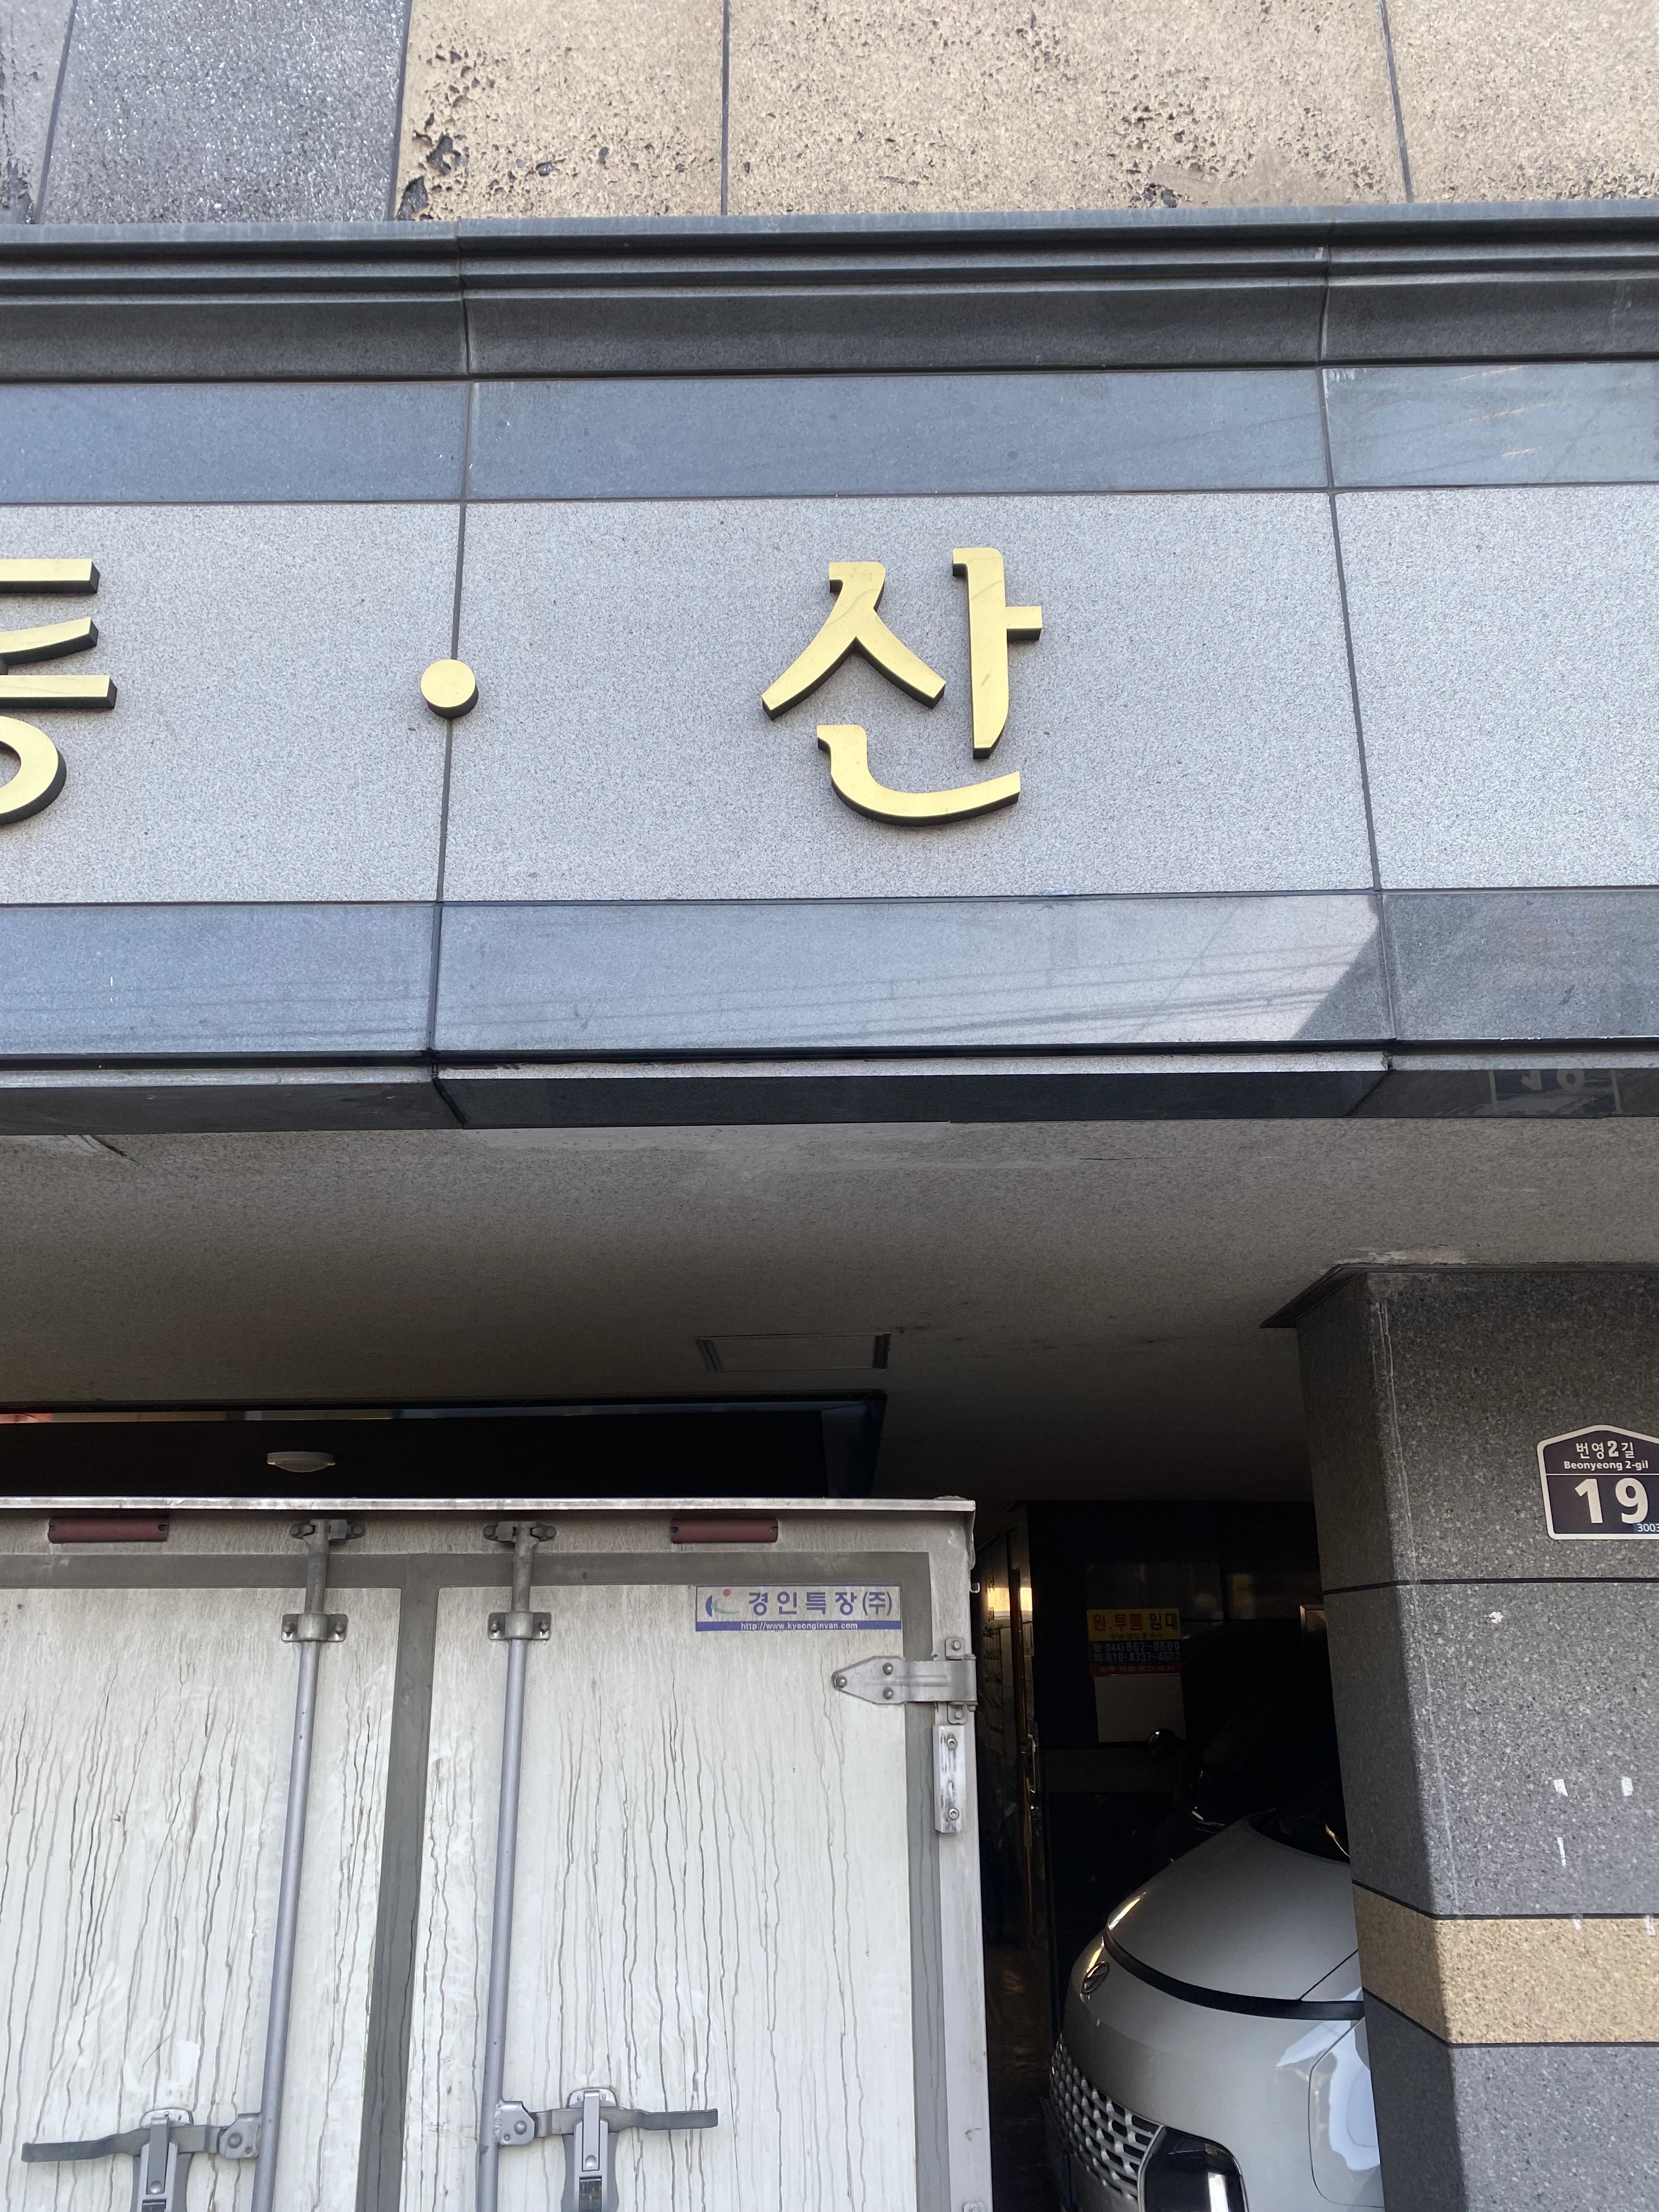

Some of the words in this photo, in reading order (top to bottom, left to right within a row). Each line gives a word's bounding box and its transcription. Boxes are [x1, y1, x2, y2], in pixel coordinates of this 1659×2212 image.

[761, 547, 1043, 826] 산
[1576, 1440, 1635, 1459] 번영2길
[1564, 1460, 1623, 1471] Beonyeong
[1626, 1460, 1649, 1471] 2-gil
[1575, 1477, 1649, 1524] 19
[741, 1622, 858, 1631] http://www.kyeonginvan.com
[1149, 1613, 1178, 1630] 임대
